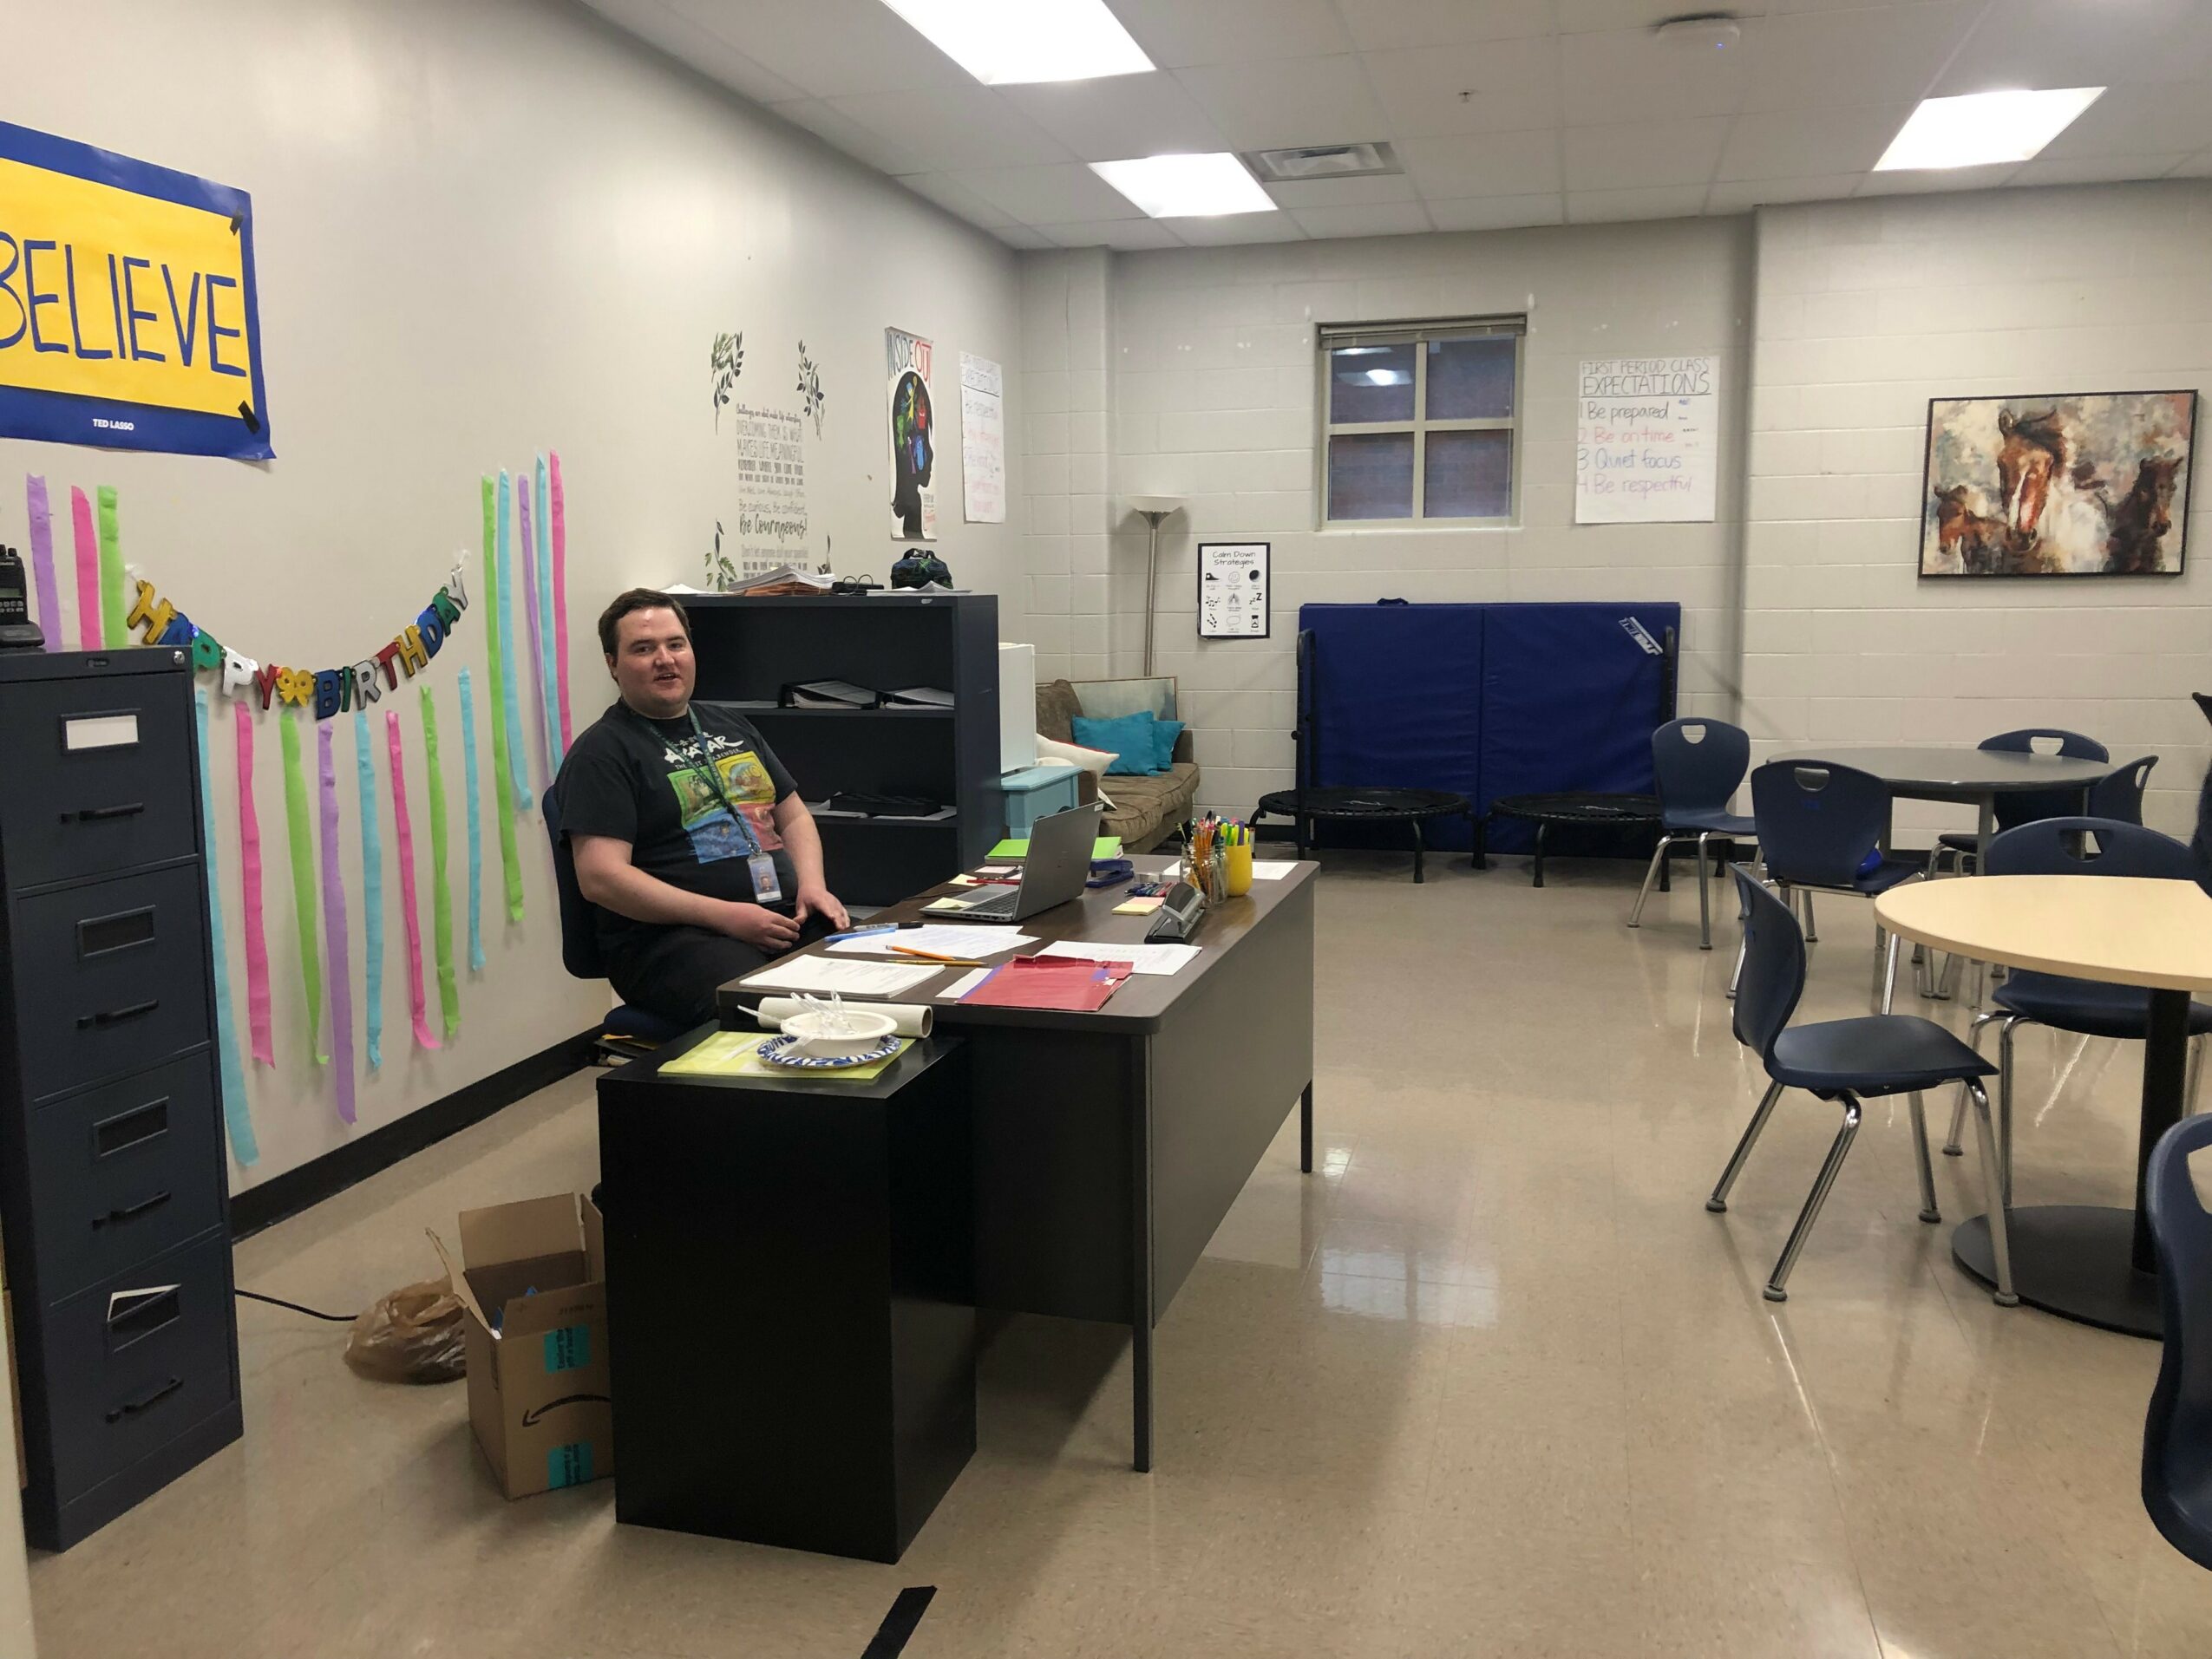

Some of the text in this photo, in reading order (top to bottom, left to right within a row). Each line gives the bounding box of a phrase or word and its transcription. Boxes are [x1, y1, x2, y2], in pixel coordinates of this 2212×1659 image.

[0, 231, 246, 376] BELIEVE
[887, 331, 932, 389] INSIDE OUT
[1582, 357, 1711, 375] FIRST PERIOD CLASS
[1582, 371, 1710, 395] EXPECTATIONS
[93, 418, 134, 431] TED LASSO
[1587, 401, 1606, 420] Be
[1611, 401, 1669, 425] prepared
[1594, 427, 1614, 444] Be
[1622, 432, 1639, 443] on
[1641, 426, 1675, 443] time
[1578, 447, 1681, 470] 3 Quiet focus
[1594, 474, 1614, 494] Be
[1622, 474, 1692, 500] respectful
[740, 513, 752, 535] Be
[1214, 558, 1254, 569] Strategies
[316, 565, 468, 720] BIRTHDAY
